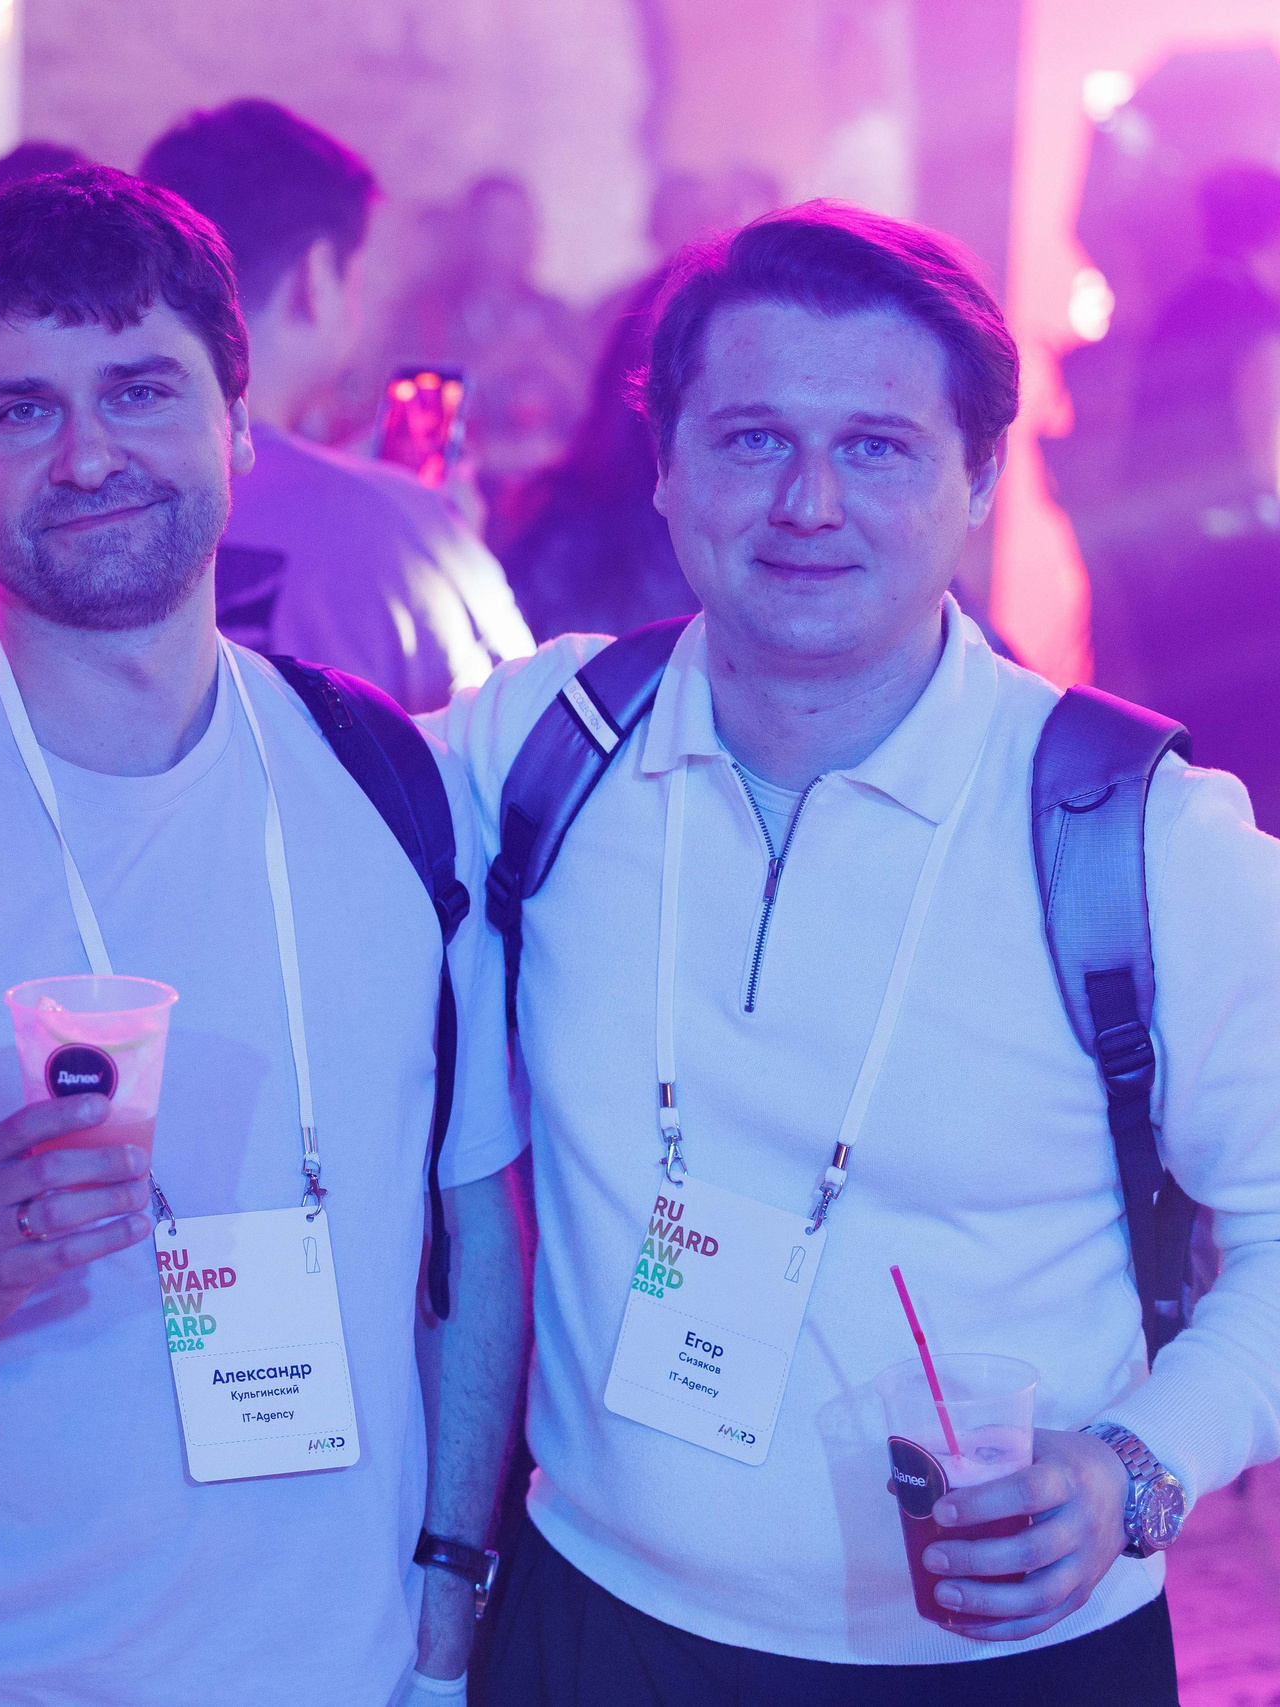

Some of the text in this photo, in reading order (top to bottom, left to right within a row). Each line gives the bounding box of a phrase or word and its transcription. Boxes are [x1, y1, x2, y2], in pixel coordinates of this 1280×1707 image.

[572, 692, 602, 731] COLLECTION
[653, 1195, 685, 1222] RU
[648, 1216, 719, 1257] WARD
[156, 1249, 189, 1272] RU
[641, 1237, 682, 1266] AW
[160, 1267, 237, 1294] WARD
[635, 1258, 684, 1289] ARD
[631, 1278, 664, 1299] 2026
[163, 1292, 203, 1316] AW
[167, 1314, 217, 1339] ARD
[169, 1338, 205, 1353] 2026
[684, 1331, 724, 1358] Егор
[212, 1362, 312, 1385] Александр
[678, 1352, 722, 1375] Сизяков
[230, 1384, 300, 1402] Кульгинский
[669, 1371, 719, 1398] IT-Agency
[242, 1409, 295, 1423] IT-Agency
